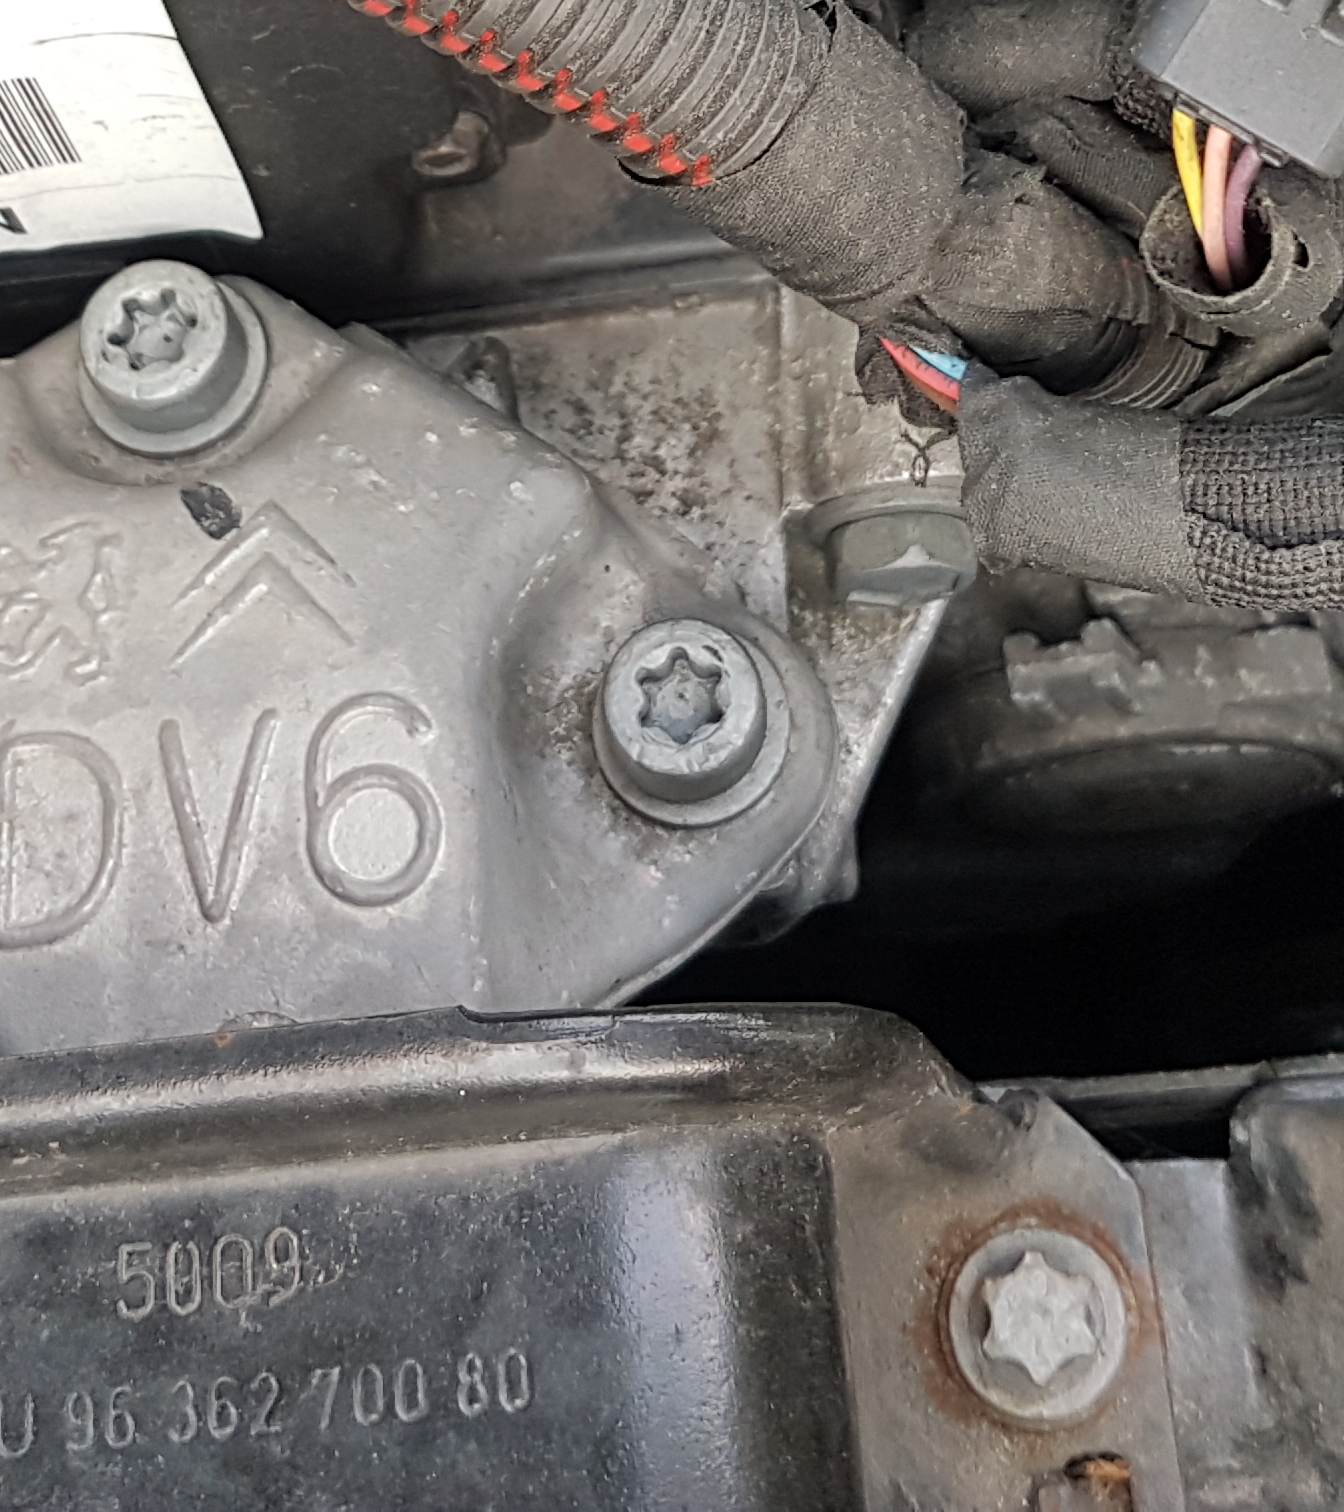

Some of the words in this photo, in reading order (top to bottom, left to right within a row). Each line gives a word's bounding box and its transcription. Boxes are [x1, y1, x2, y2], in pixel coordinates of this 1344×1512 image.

[115, 1225, 305, 1320] 5009
[64, 1388, 139, 1454] 96
[167, 1375, 285, 1444] 362
[308, 1357, 432, 1433] 700
[455, 1346, 537, 1419] 80
